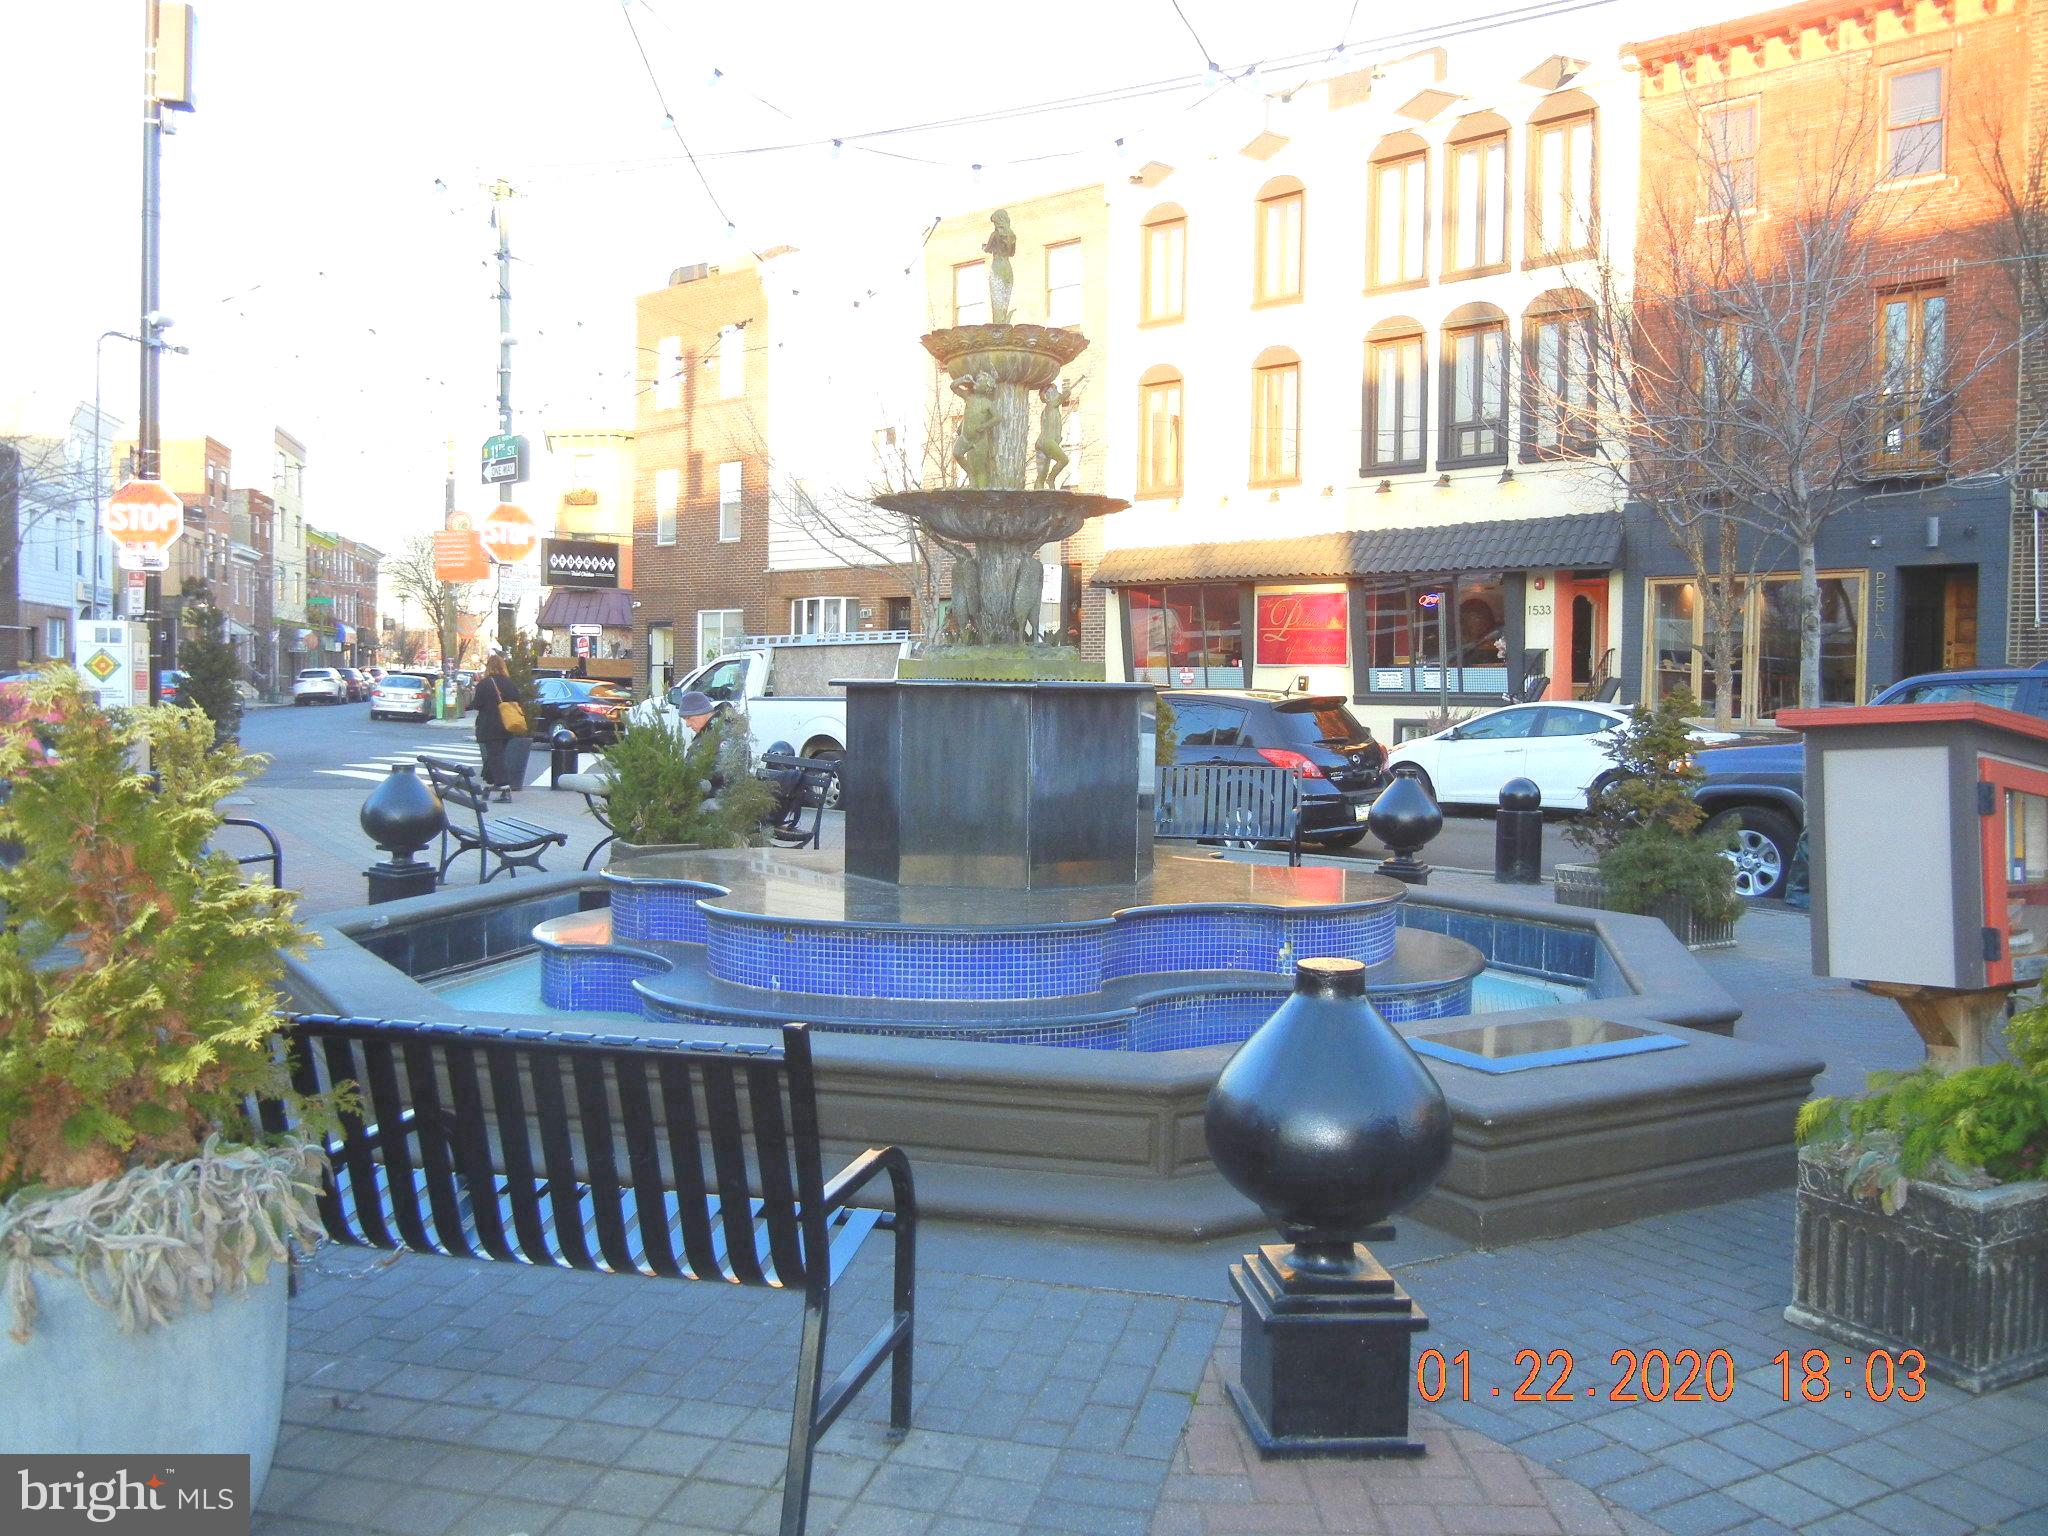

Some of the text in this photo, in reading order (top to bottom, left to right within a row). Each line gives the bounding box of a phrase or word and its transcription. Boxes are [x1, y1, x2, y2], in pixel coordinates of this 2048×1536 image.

[507, 445, 516, 456] ST
[491, 463, 514, 476] ONE WAY
[110, 503, 177, 531] STOP
[482, 522, 534, 544] STOP
[1528, 605, 1551, 616] 1533
[1873, 572, 1886, 640] PERLA
